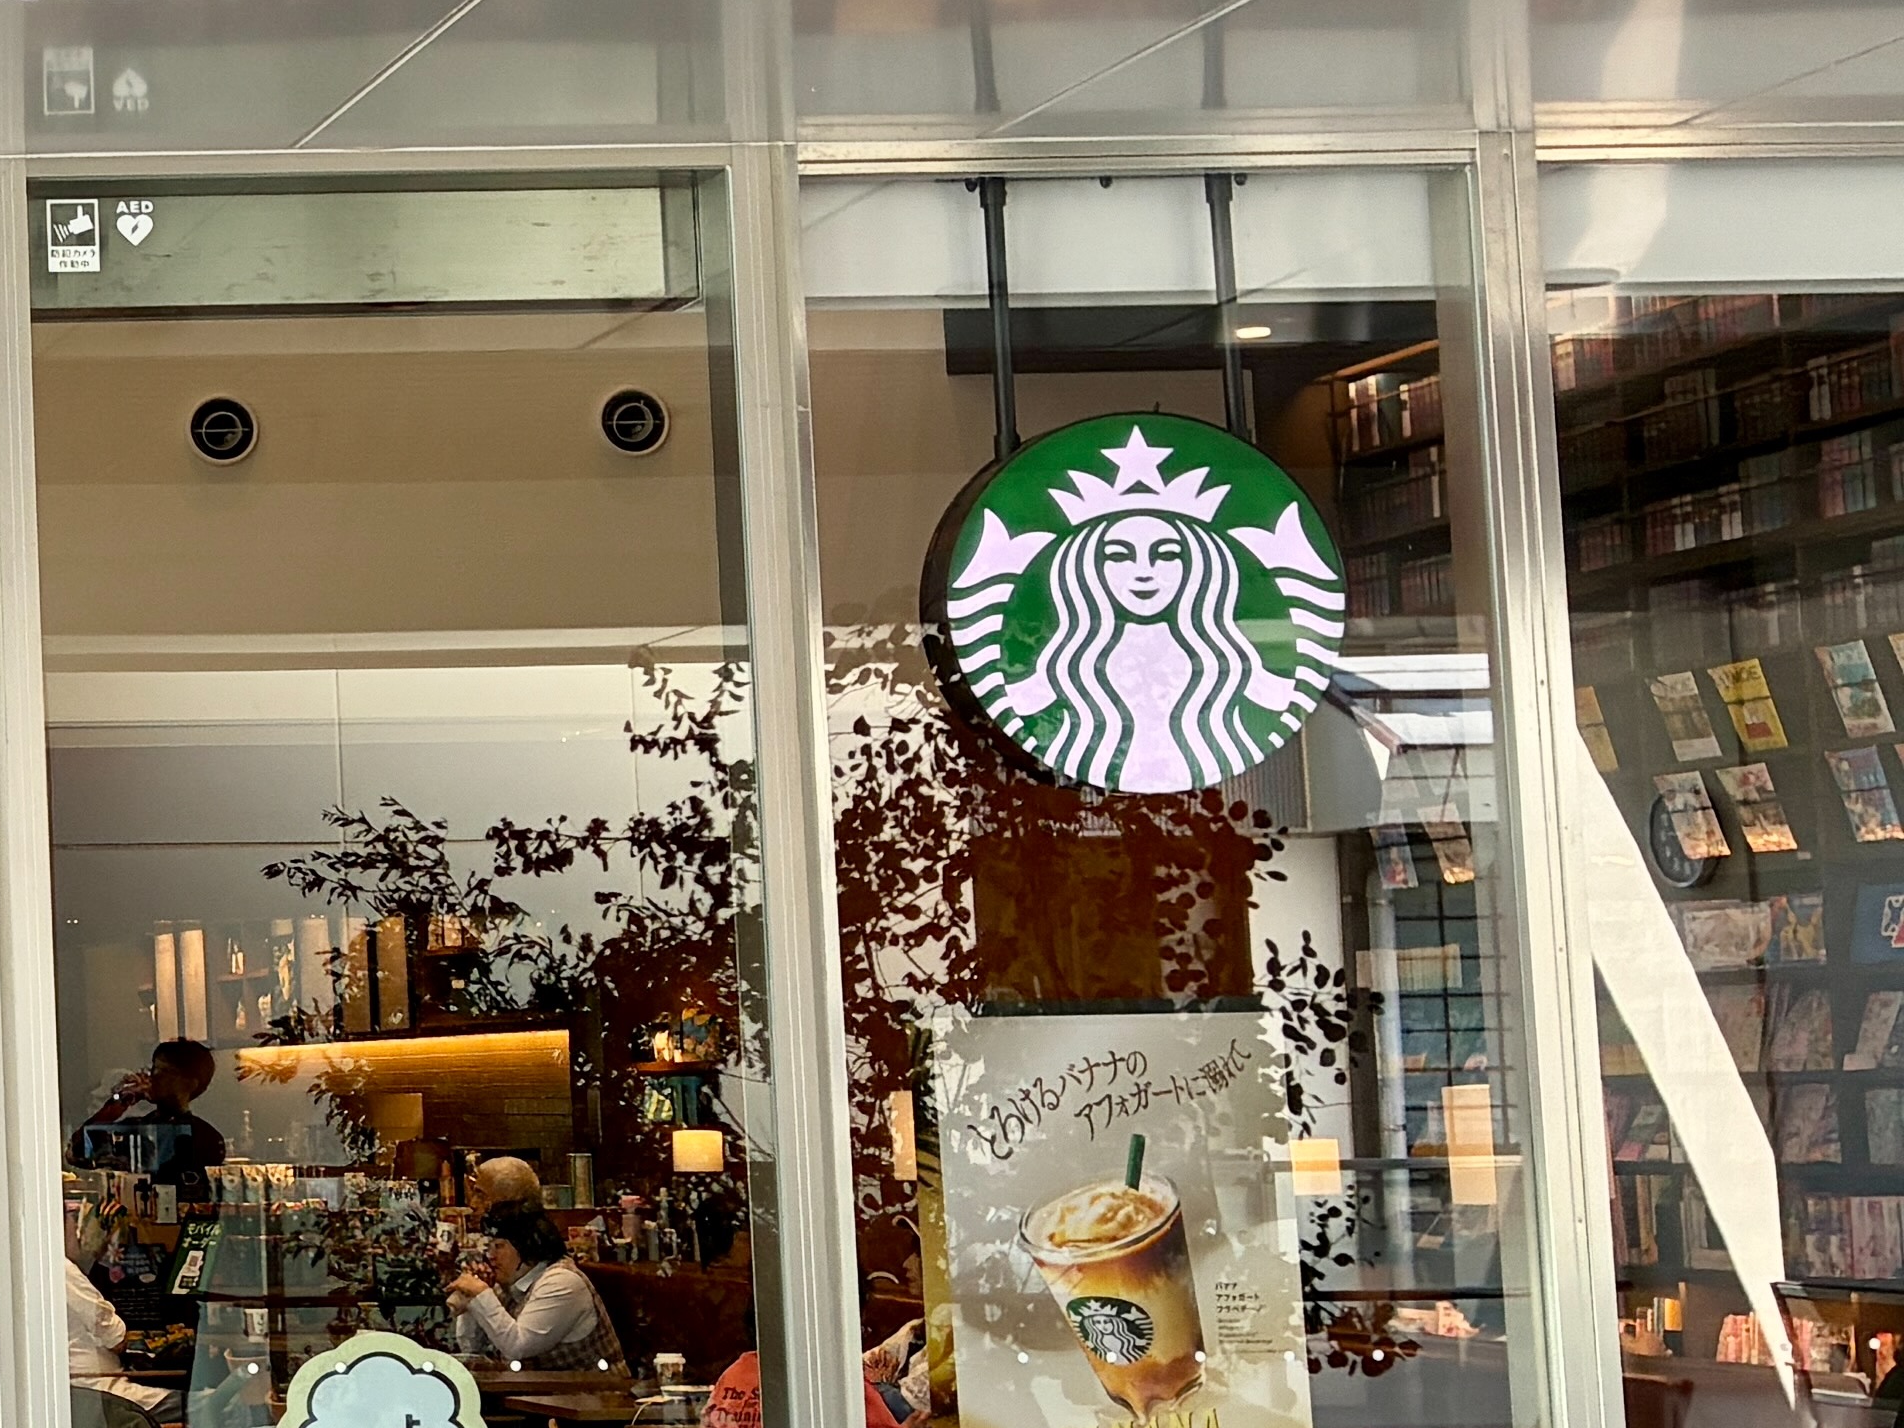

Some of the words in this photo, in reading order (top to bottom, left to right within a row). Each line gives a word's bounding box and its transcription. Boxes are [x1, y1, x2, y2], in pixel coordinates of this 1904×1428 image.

[116, 201, 154, 213] AED
[967, 1051, 1147, 1160] とろけるバナナの
